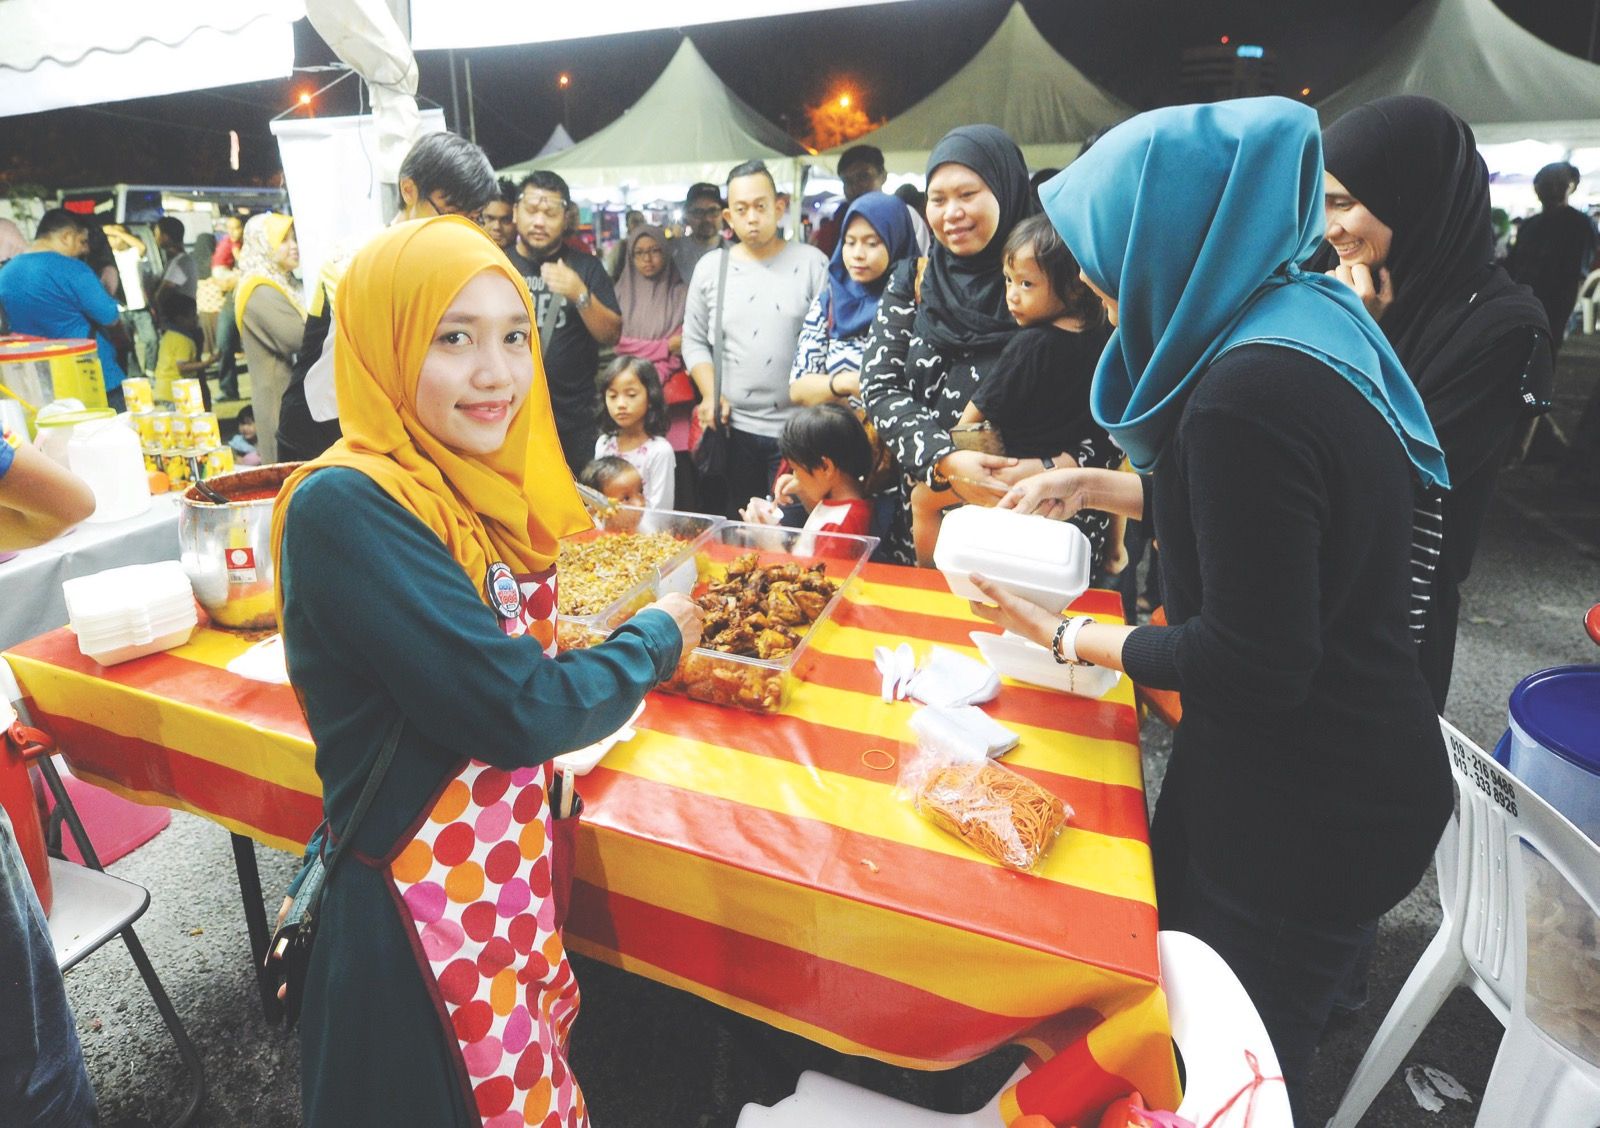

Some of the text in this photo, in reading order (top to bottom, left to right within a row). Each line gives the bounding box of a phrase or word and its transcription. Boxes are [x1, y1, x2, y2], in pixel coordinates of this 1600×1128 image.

[1453, 752, 1468, 776] 013
[1474, 772, 1491, 796] 333
[1472, 754, 1489, 779] 216
[1490, 769, 1515, 799] 9486
